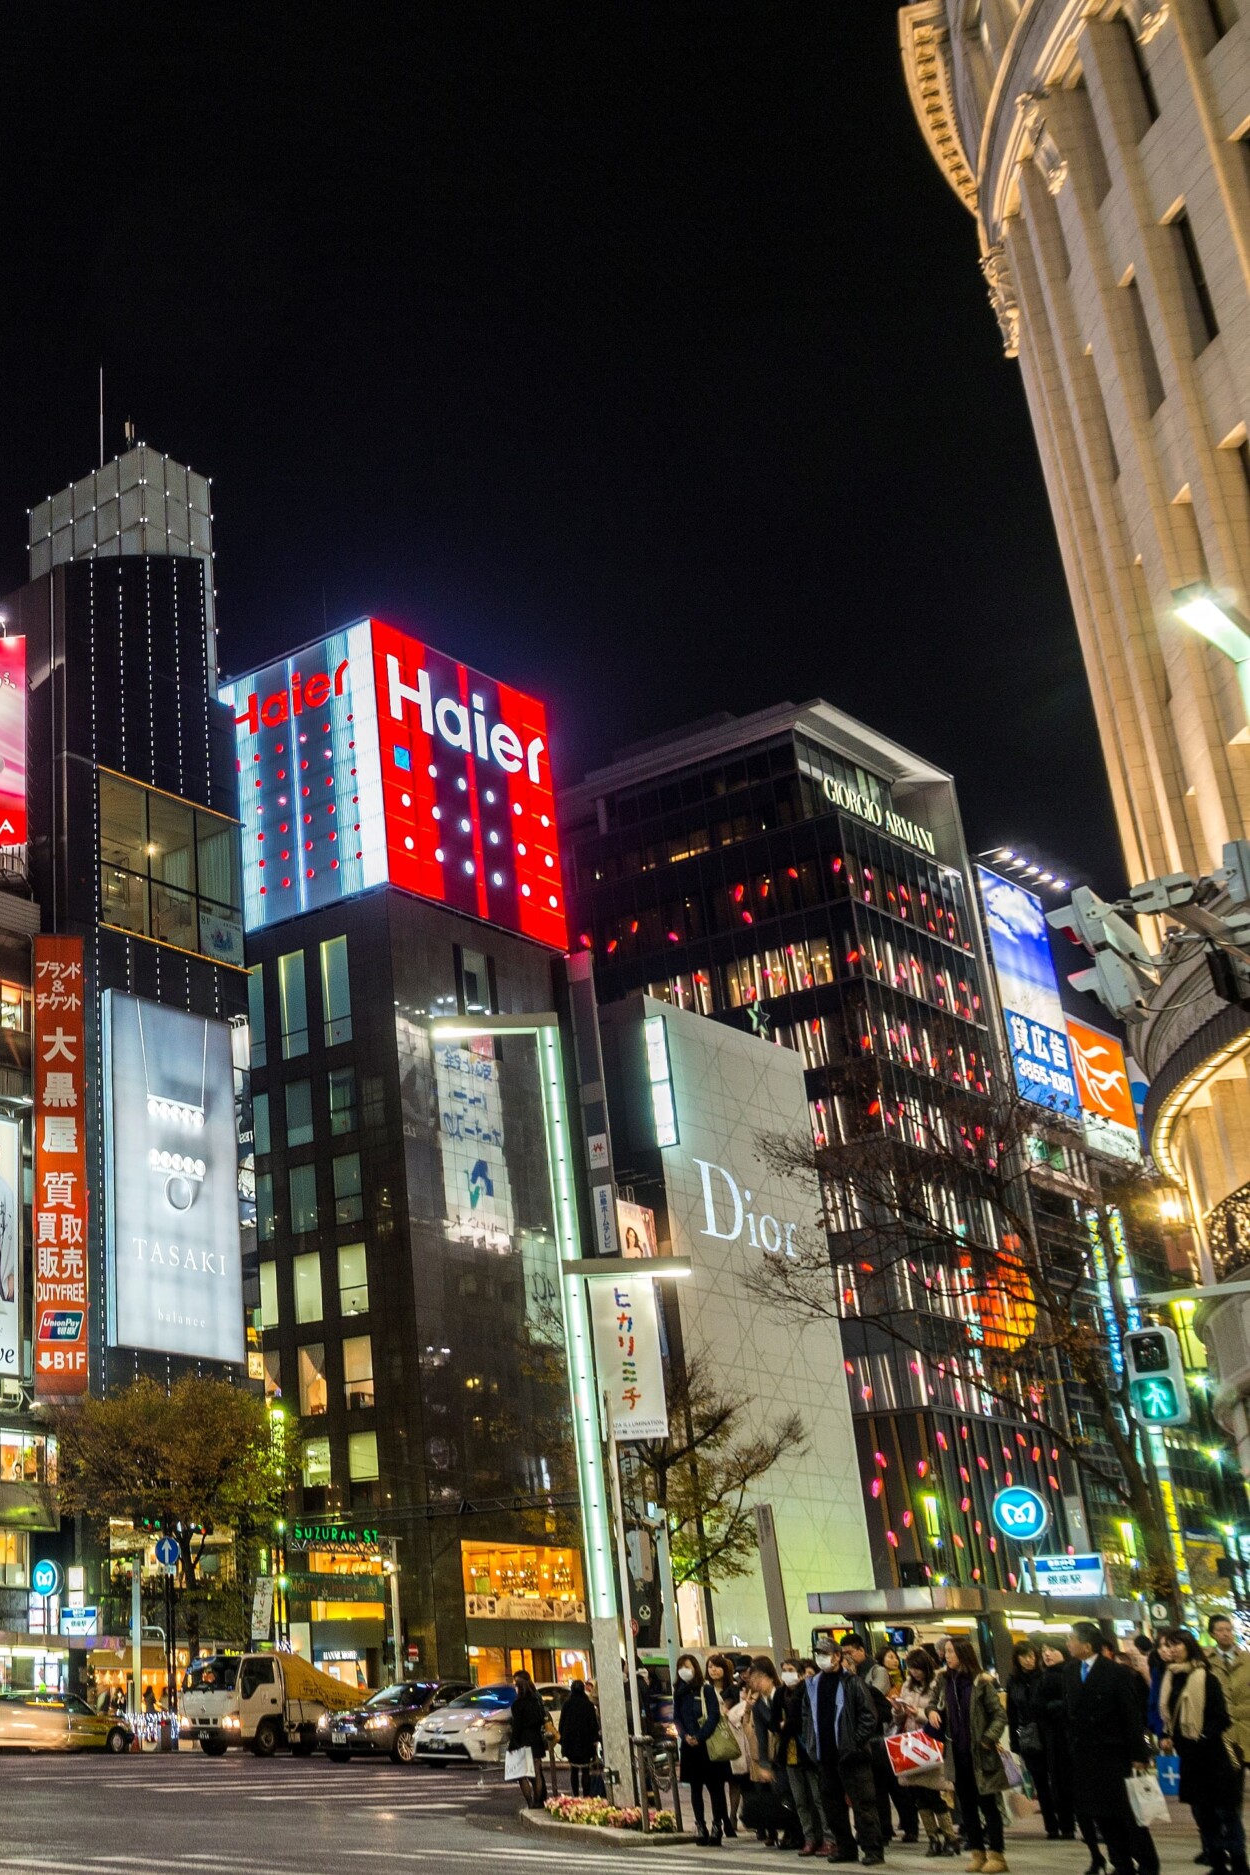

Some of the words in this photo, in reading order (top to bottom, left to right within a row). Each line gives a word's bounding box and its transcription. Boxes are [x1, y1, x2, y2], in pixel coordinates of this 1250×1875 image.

[231, 658, 350, 736] Haier
[386, 653, 545, 785] Haier
[824, 776, 882, 827] GIORGIO
[884, 810, 936, 856] ARMANI
[36, 960, 82, 979] ブランド
[36, 992, 82, 1011] チケット
[51, 980, 65, 993] &
[1010, 1015, 1069, 1071] 貸広告
[41, 1026, 78, 1154] 大黒屋
[42, 1172, 78, 1209] 質
[692, 1157, 797, 1258] Dior
[37, 1212, 83, 1244] 買取
[37, 1247, 84, 1280] 販売
[132, 1236, 227, 1276] TASAKI
[43, 1317, 80, 1328] UnionPay
[157, 1307, 207, 1329] balance
[54, 1351, 86, 1370] B1F
[613, 1287, 642, 1411] ヒカリミチ
[293, 1524, 357, 1541] SUZURAN
[363, 1529, 380, 1543] ST
[291, 1578, 319, 1598] Merry
